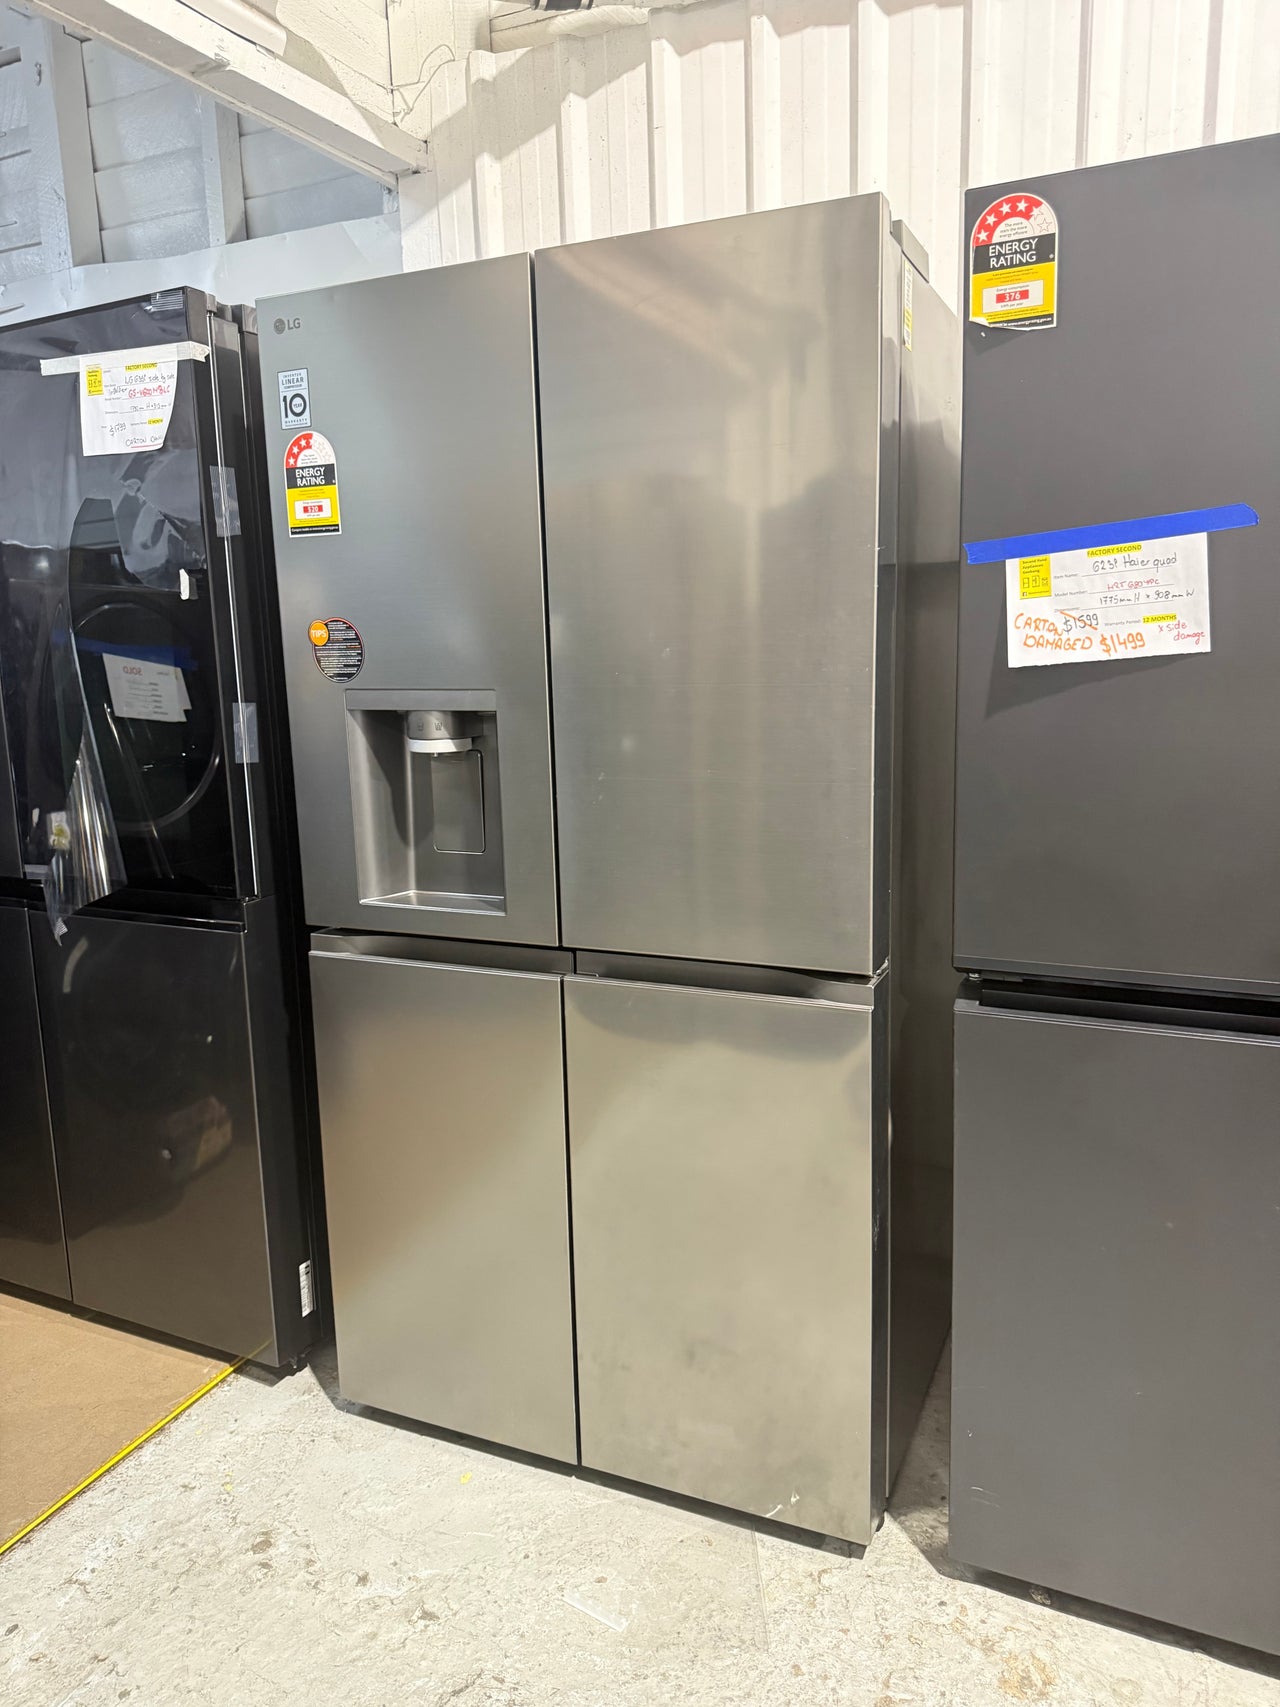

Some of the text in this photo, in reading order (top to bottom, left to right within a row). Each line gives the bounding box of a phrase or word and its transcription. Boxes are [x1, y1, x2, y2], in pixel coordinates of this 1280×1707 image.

[989, 238, 1039, 257] ENERGY
[990, 251, 1037, 268] RATING
[1004, 291, 1021, 302] 376
[287, 317, 301, 330] LG
[281, 377, 304, 385] LINEAR
[283, 393, 307, 418] 10
[295, 467, 325, 478] ENERGY
[297, 476, 326, 487] RATING
[1087, 545, 1142, 557] FACTORY SECOND
[1123, 553, 1151, 569] Haier
[1014, 612, 1064, 637] CARTON
[1150, 614, 1177, 622] MONTHS
[1166, 619, 1187, 632] side
[311, 629, 327, 638] TIPS
[1173, 628, 1206, 645] damage
[1023, 633, 1093, 651] DAMAGED
[1099, 631, 1145, 657] $1499
